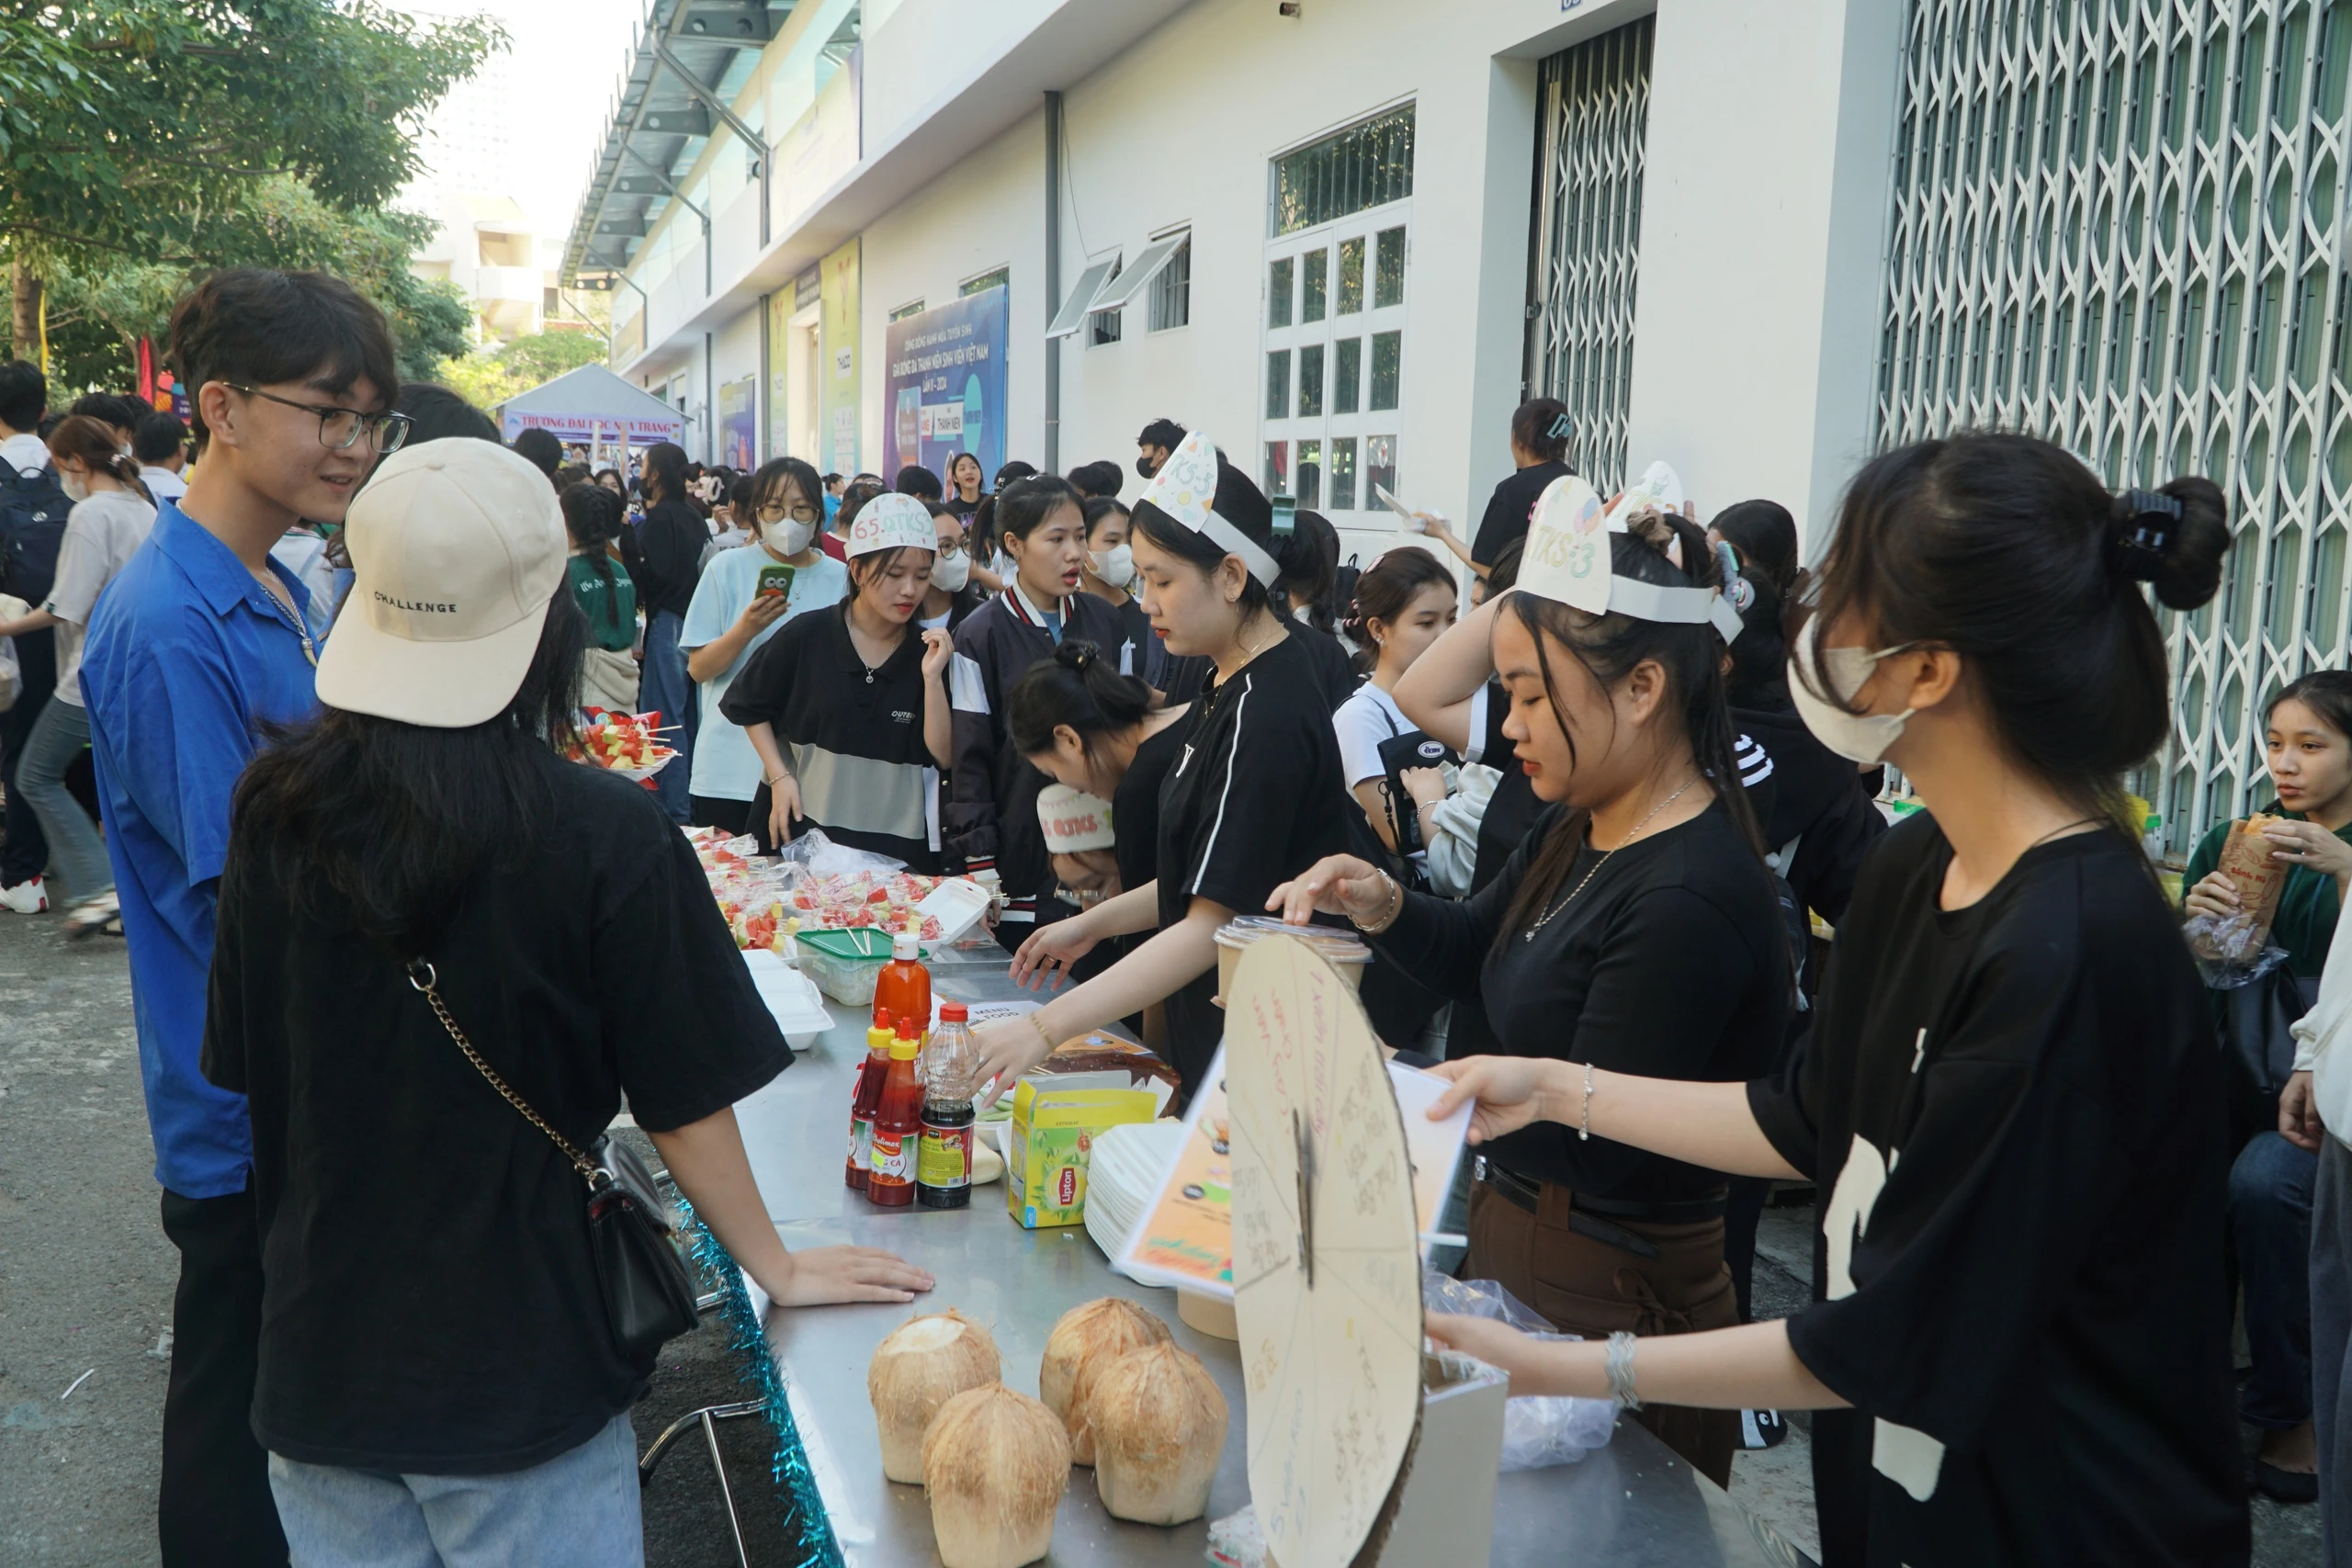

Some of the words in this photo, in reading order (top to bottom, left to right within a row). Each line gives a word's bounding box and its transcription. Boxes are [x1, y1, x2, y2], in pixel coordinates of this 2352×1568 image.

[976, 343, 989, 361] NAM
[614, 421, 635, 432] NA
[638, 421, 672, 434] TRANG
[374, 591, 457, 614] CHALLENGE
[974, 1007, 1010, 1016] MENU
[984, 1011, 1020, 1021] FOOD
[1062, 1170, 1072, 1202] Lipton
